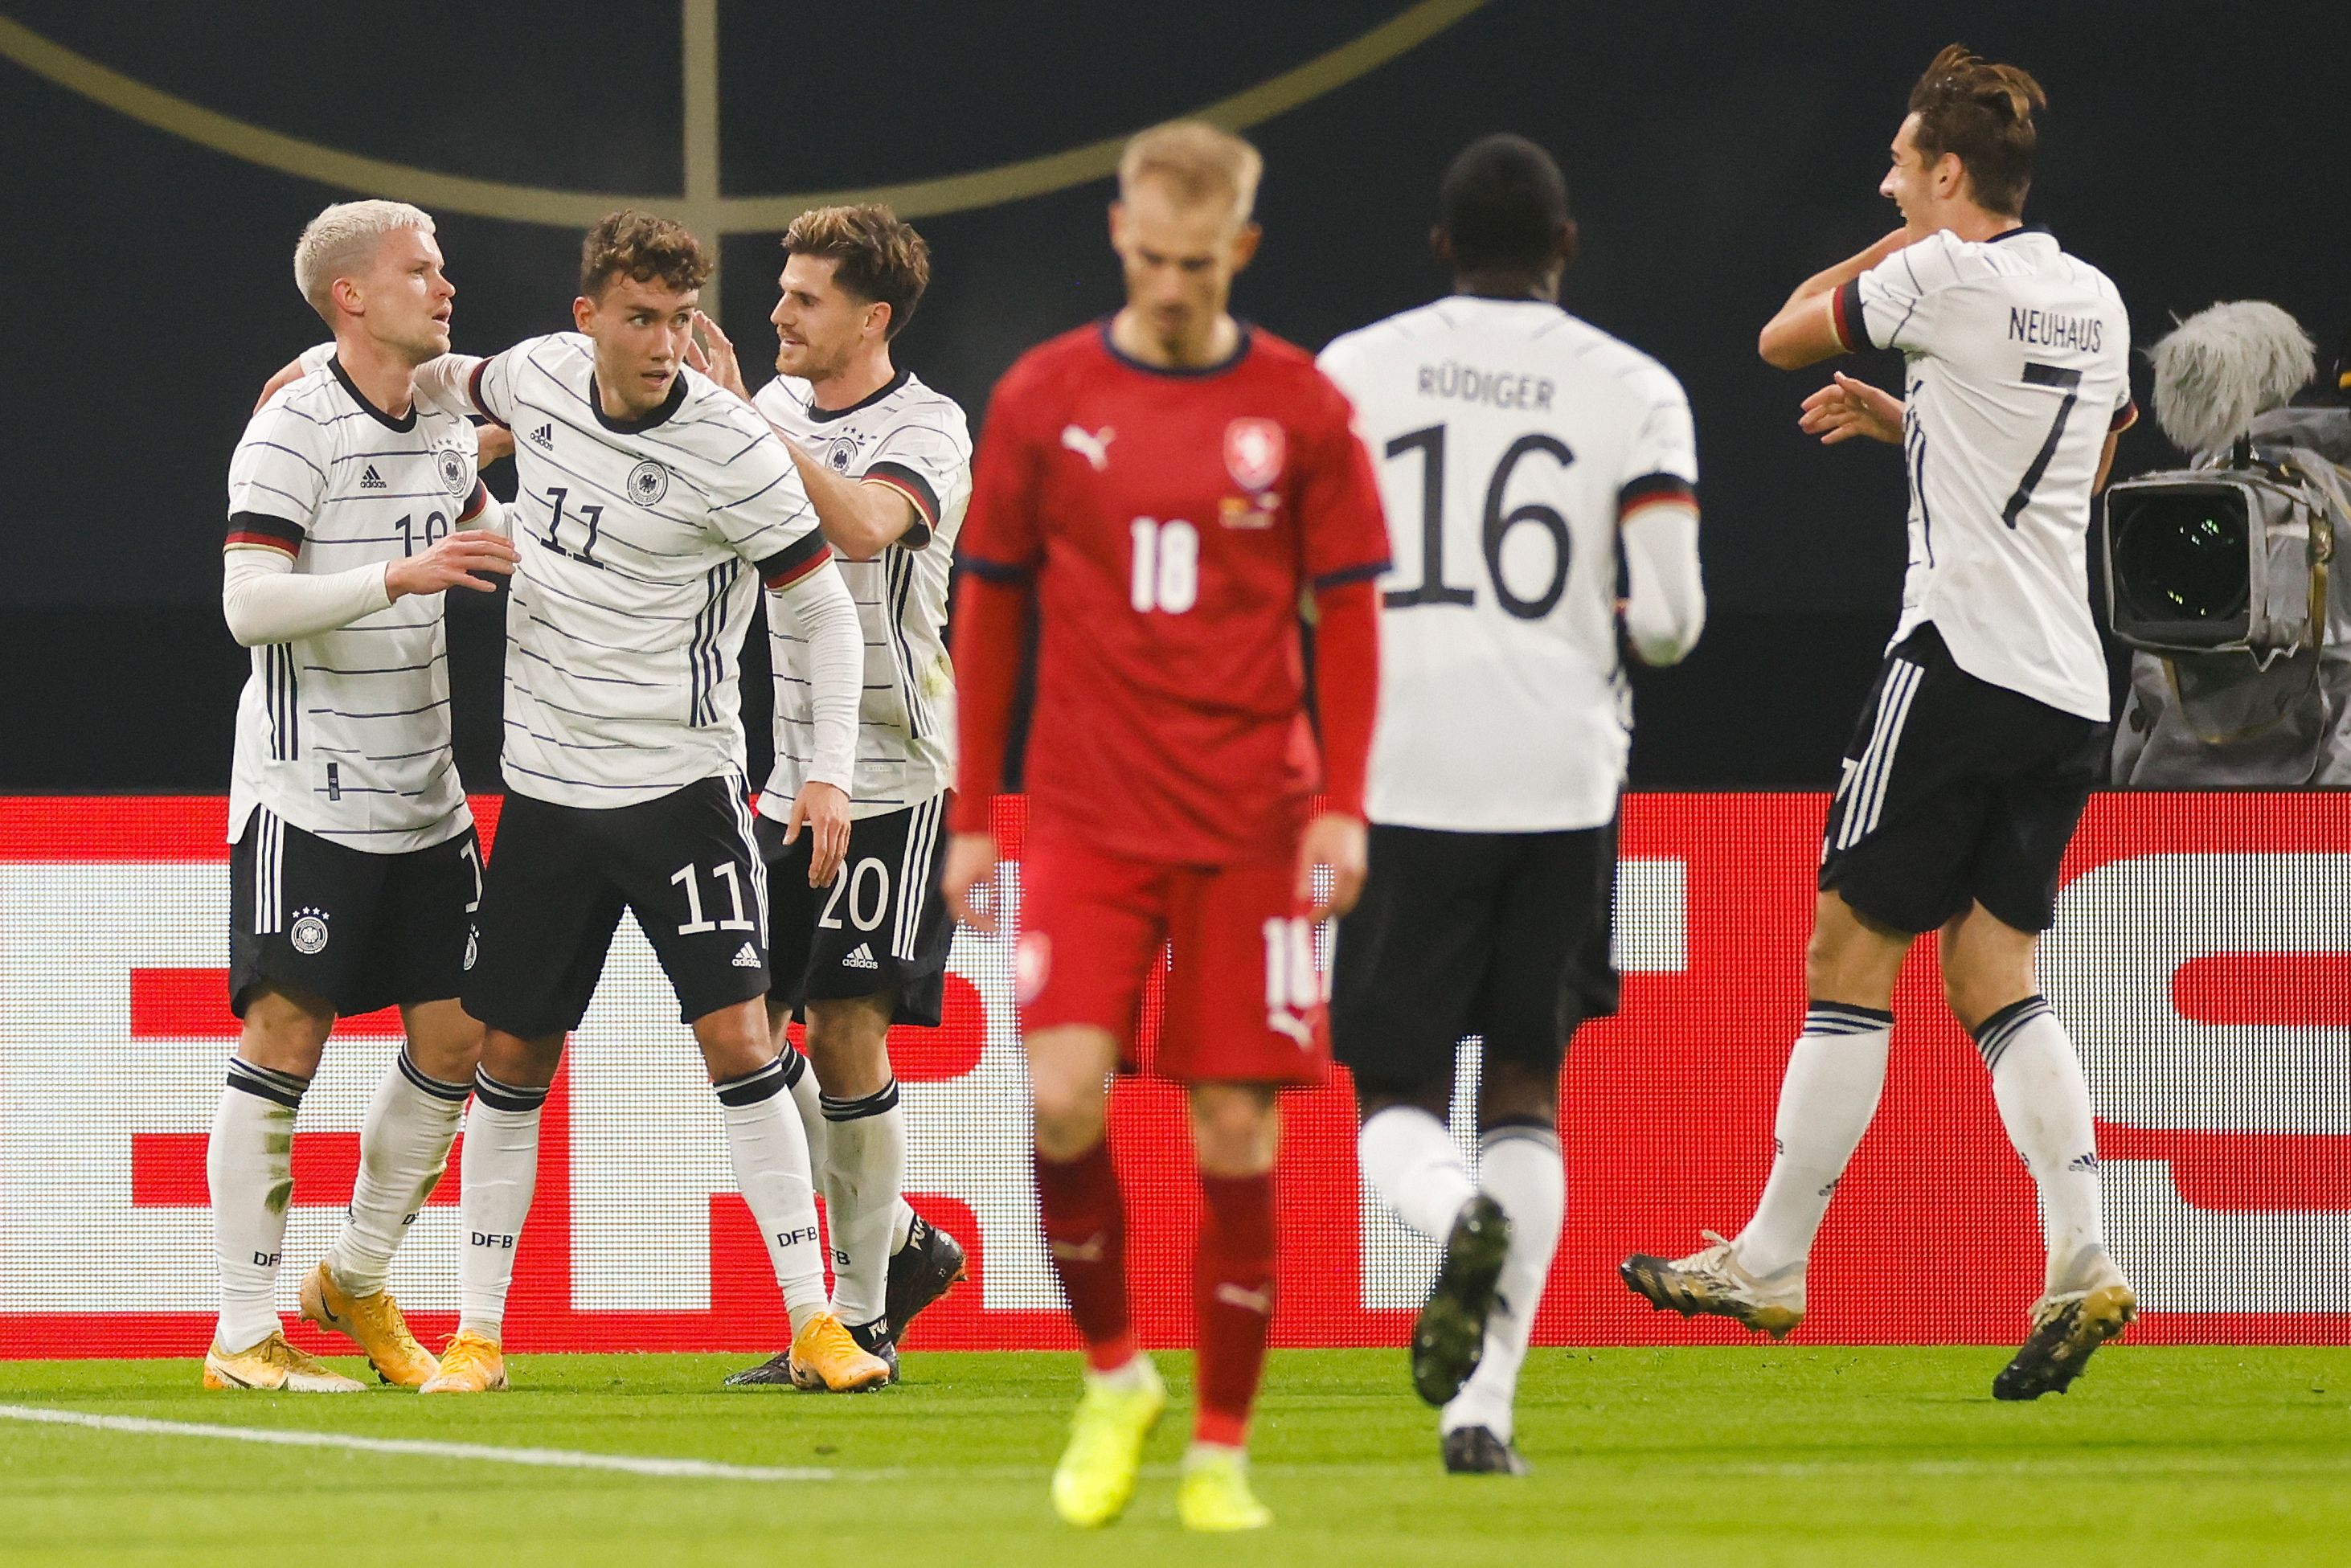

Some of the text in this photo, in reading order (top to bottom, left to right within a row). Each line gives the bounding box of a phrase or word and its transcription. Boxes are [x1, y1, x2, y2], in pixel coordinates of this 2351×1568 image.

[2009, 306, 2103, 354] NEUHAUS
[1417, 360, 1556, 412] RÜDIGER
[530, 432, 555, 452] adidas
[2001, 361, 2083, 530] 7
[360, 480, 387, 489] adidas
[540, 487, 604, 570] 11
[1383, 424, 1575, 620] 16
[1129, 515, 1199, 614] 18
[670, 861, 756, 935] 11
[818, 857, 890, 931] 20
[732, 956, 762, 969] adidas
[842, 956, 879, 970] adidas
[471, 1231, 514, 1249] DFB
[776, 1226, 818, 1247] DFB
